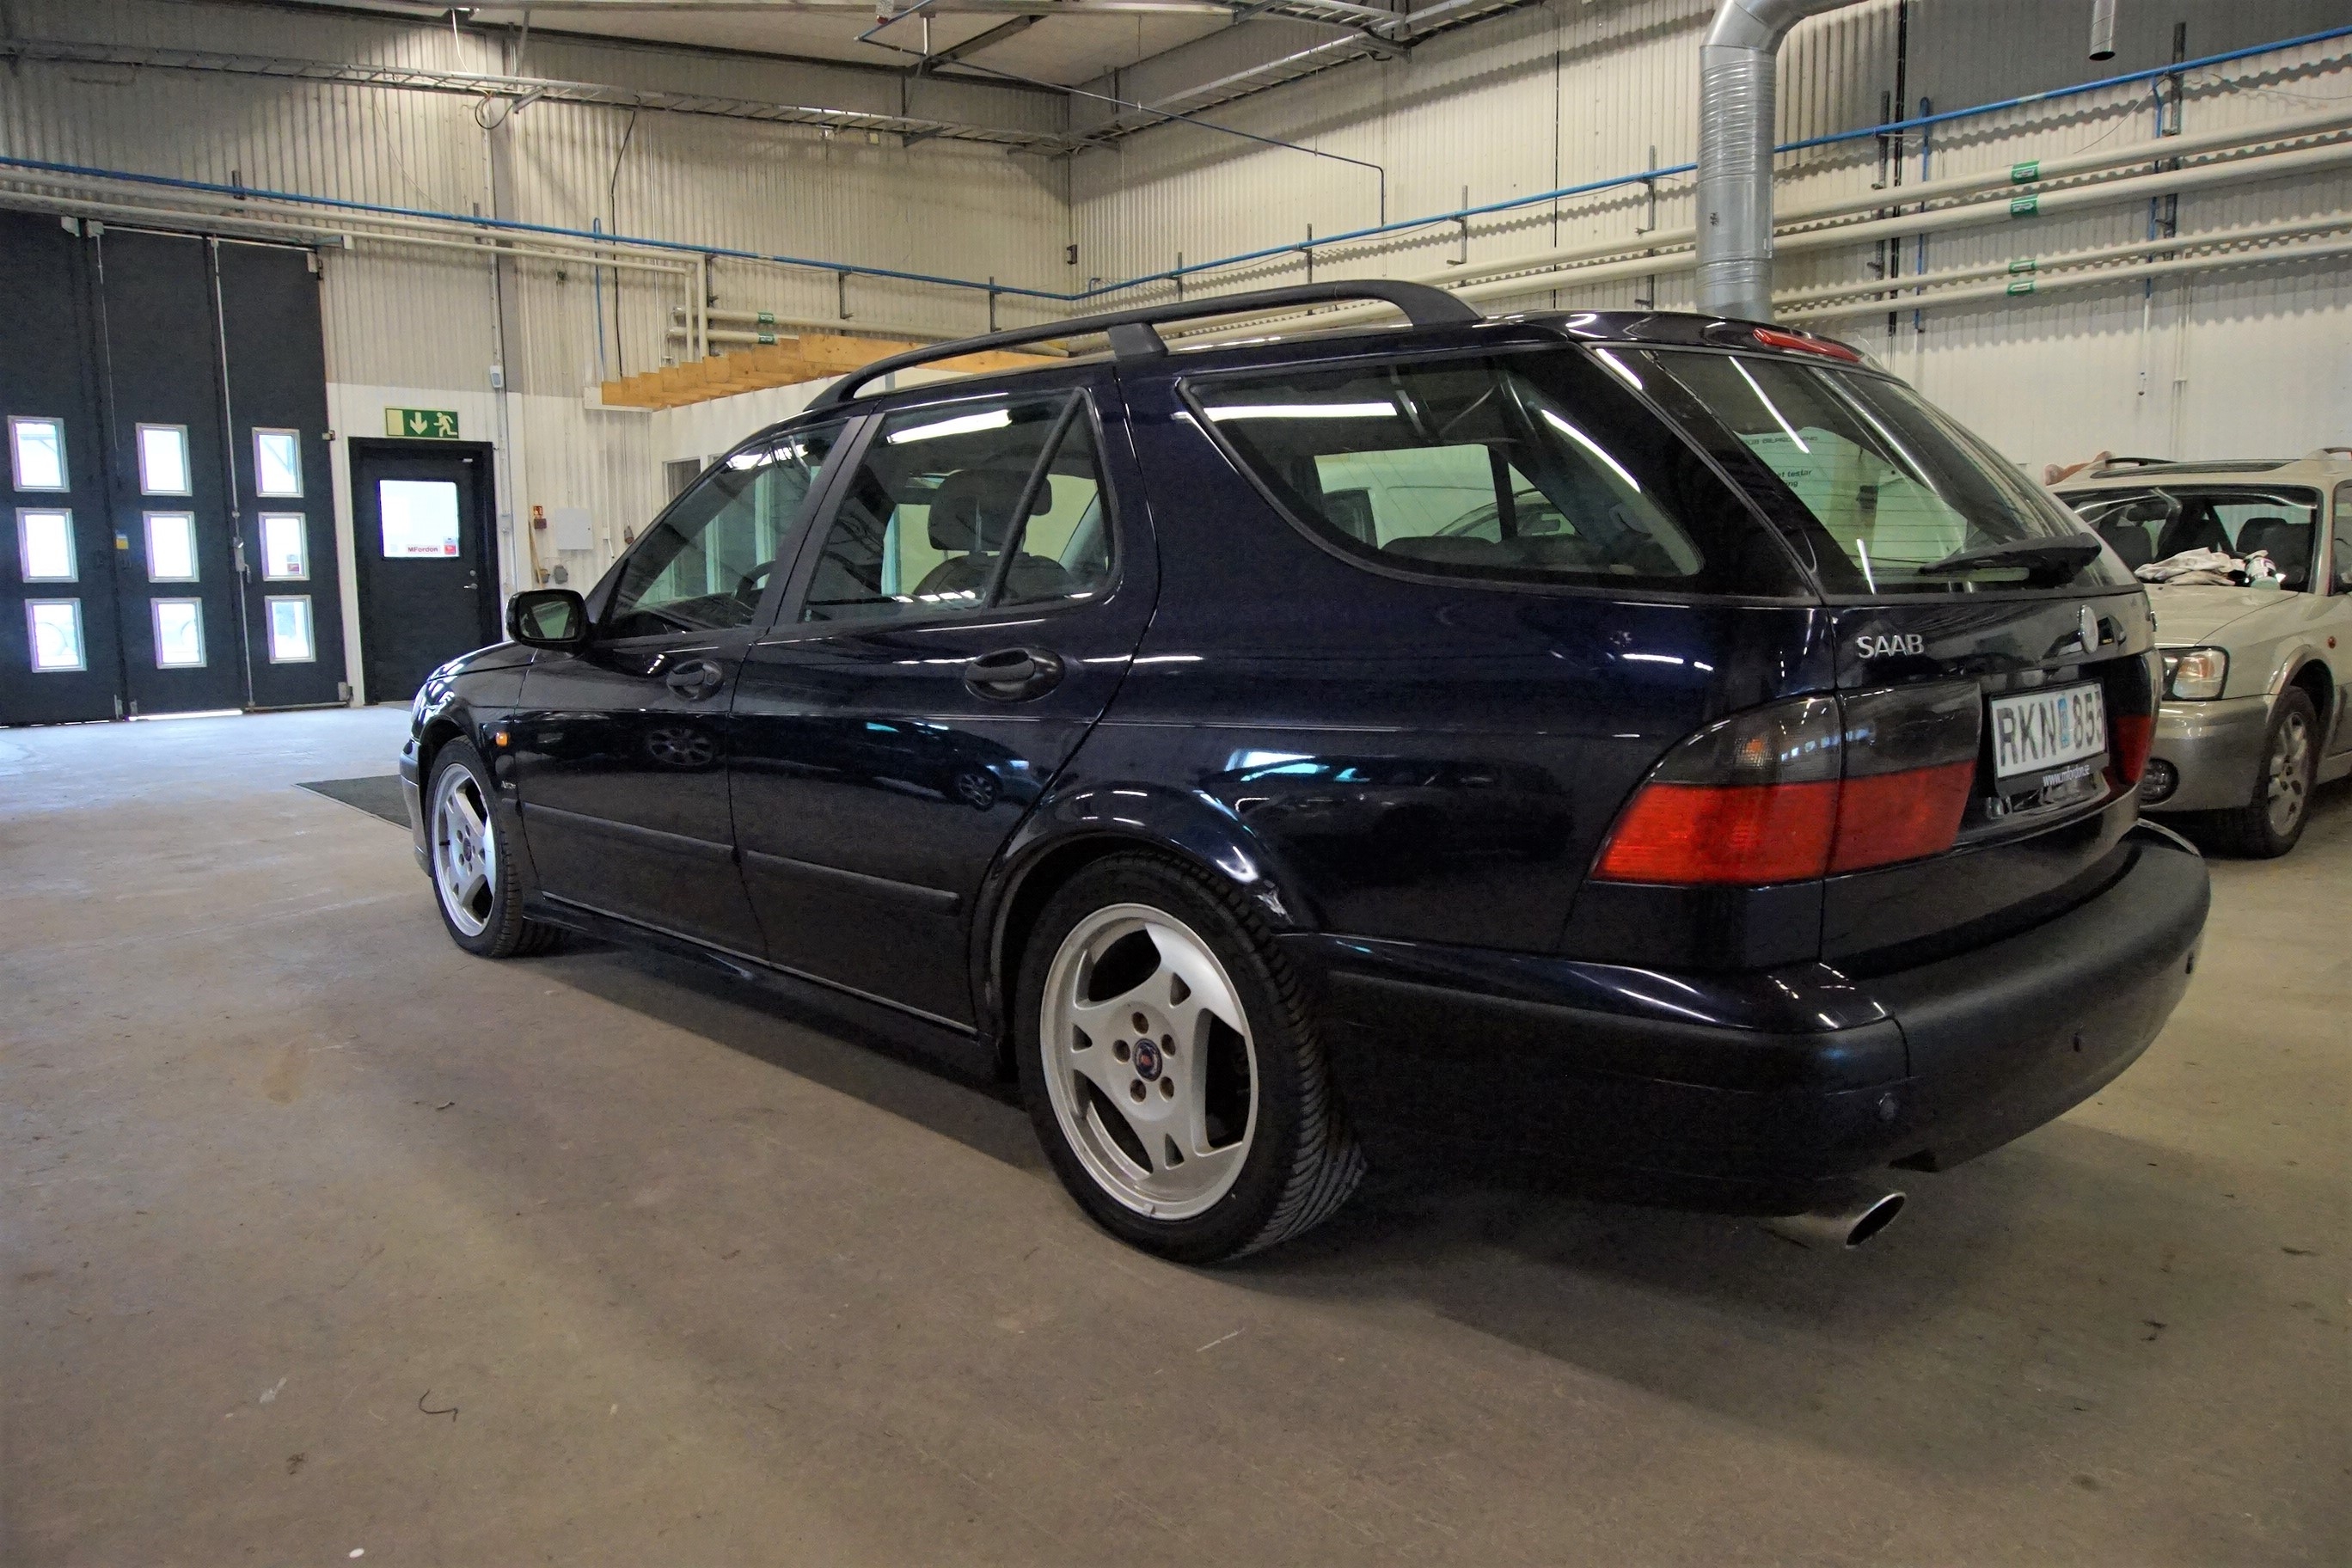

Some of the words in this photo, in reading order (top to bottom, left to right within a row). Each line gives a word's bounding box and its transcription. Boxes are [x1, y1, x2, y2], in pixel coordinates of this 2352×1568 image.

[1856, 634, 1925, 658] SAAB
[1996, 700, 2057, 767] RKN
[2073, 690, 2104, 750] 855
